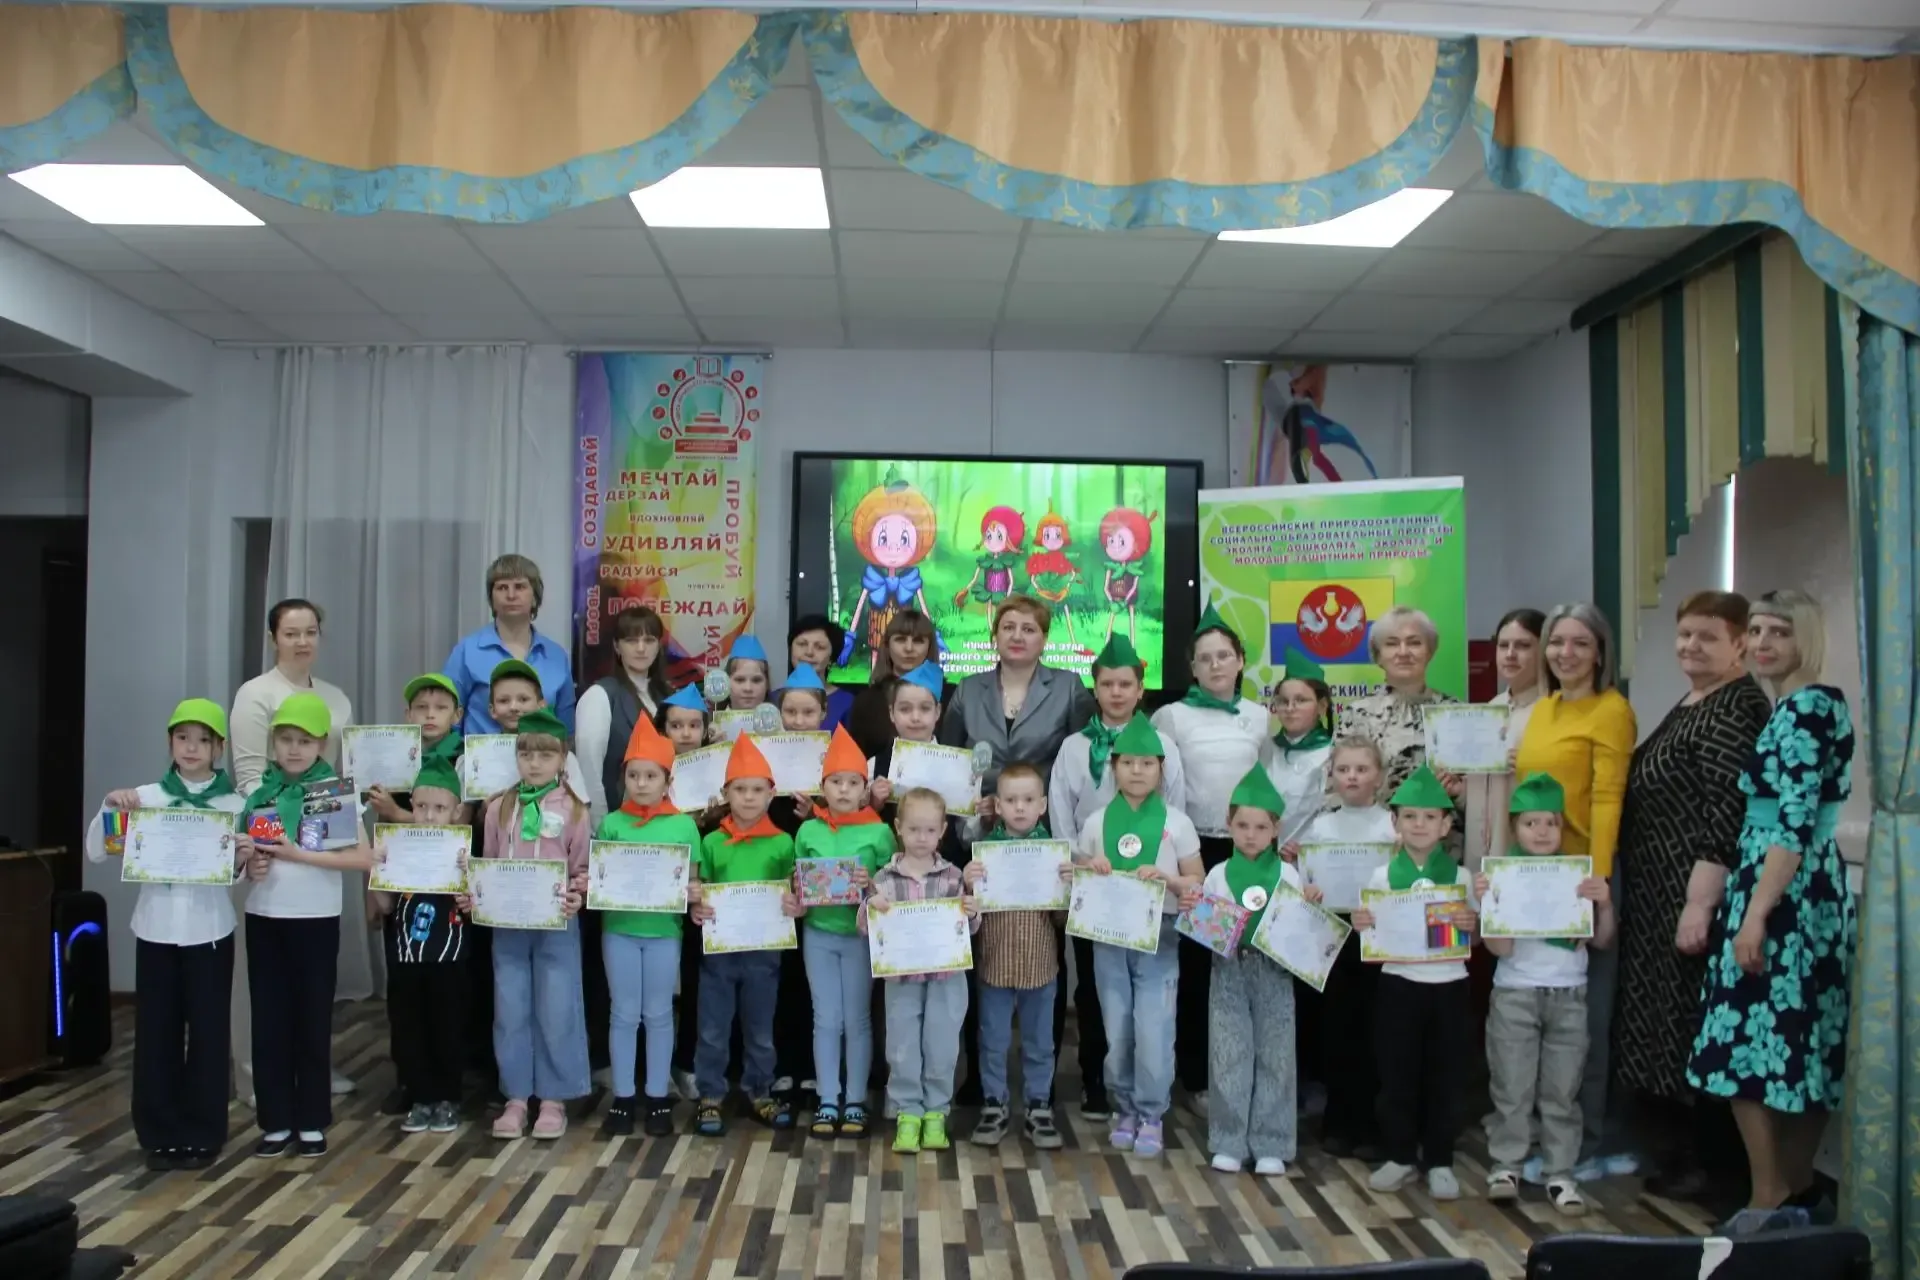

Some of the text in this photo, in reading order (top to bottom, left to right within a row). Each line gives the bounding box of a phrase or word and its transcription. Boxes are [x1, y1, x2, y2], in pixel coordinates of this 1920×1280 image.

[621, 468, 717, 486] МЕЧТАЙ
[583, 437, 599, 547] СОЗДАВАЙ
[605, 488, 670, 502] ДЕРЗАЙ
[630, 513, 704, 523] ВДОХНОВЛЯЙ
[725, 479, 742, 578] ПРОБУЙ
[606, 534, 721, 552] УДИВЛЯЙ
[601, 565, 678, 578] РАДУЙСЯ
